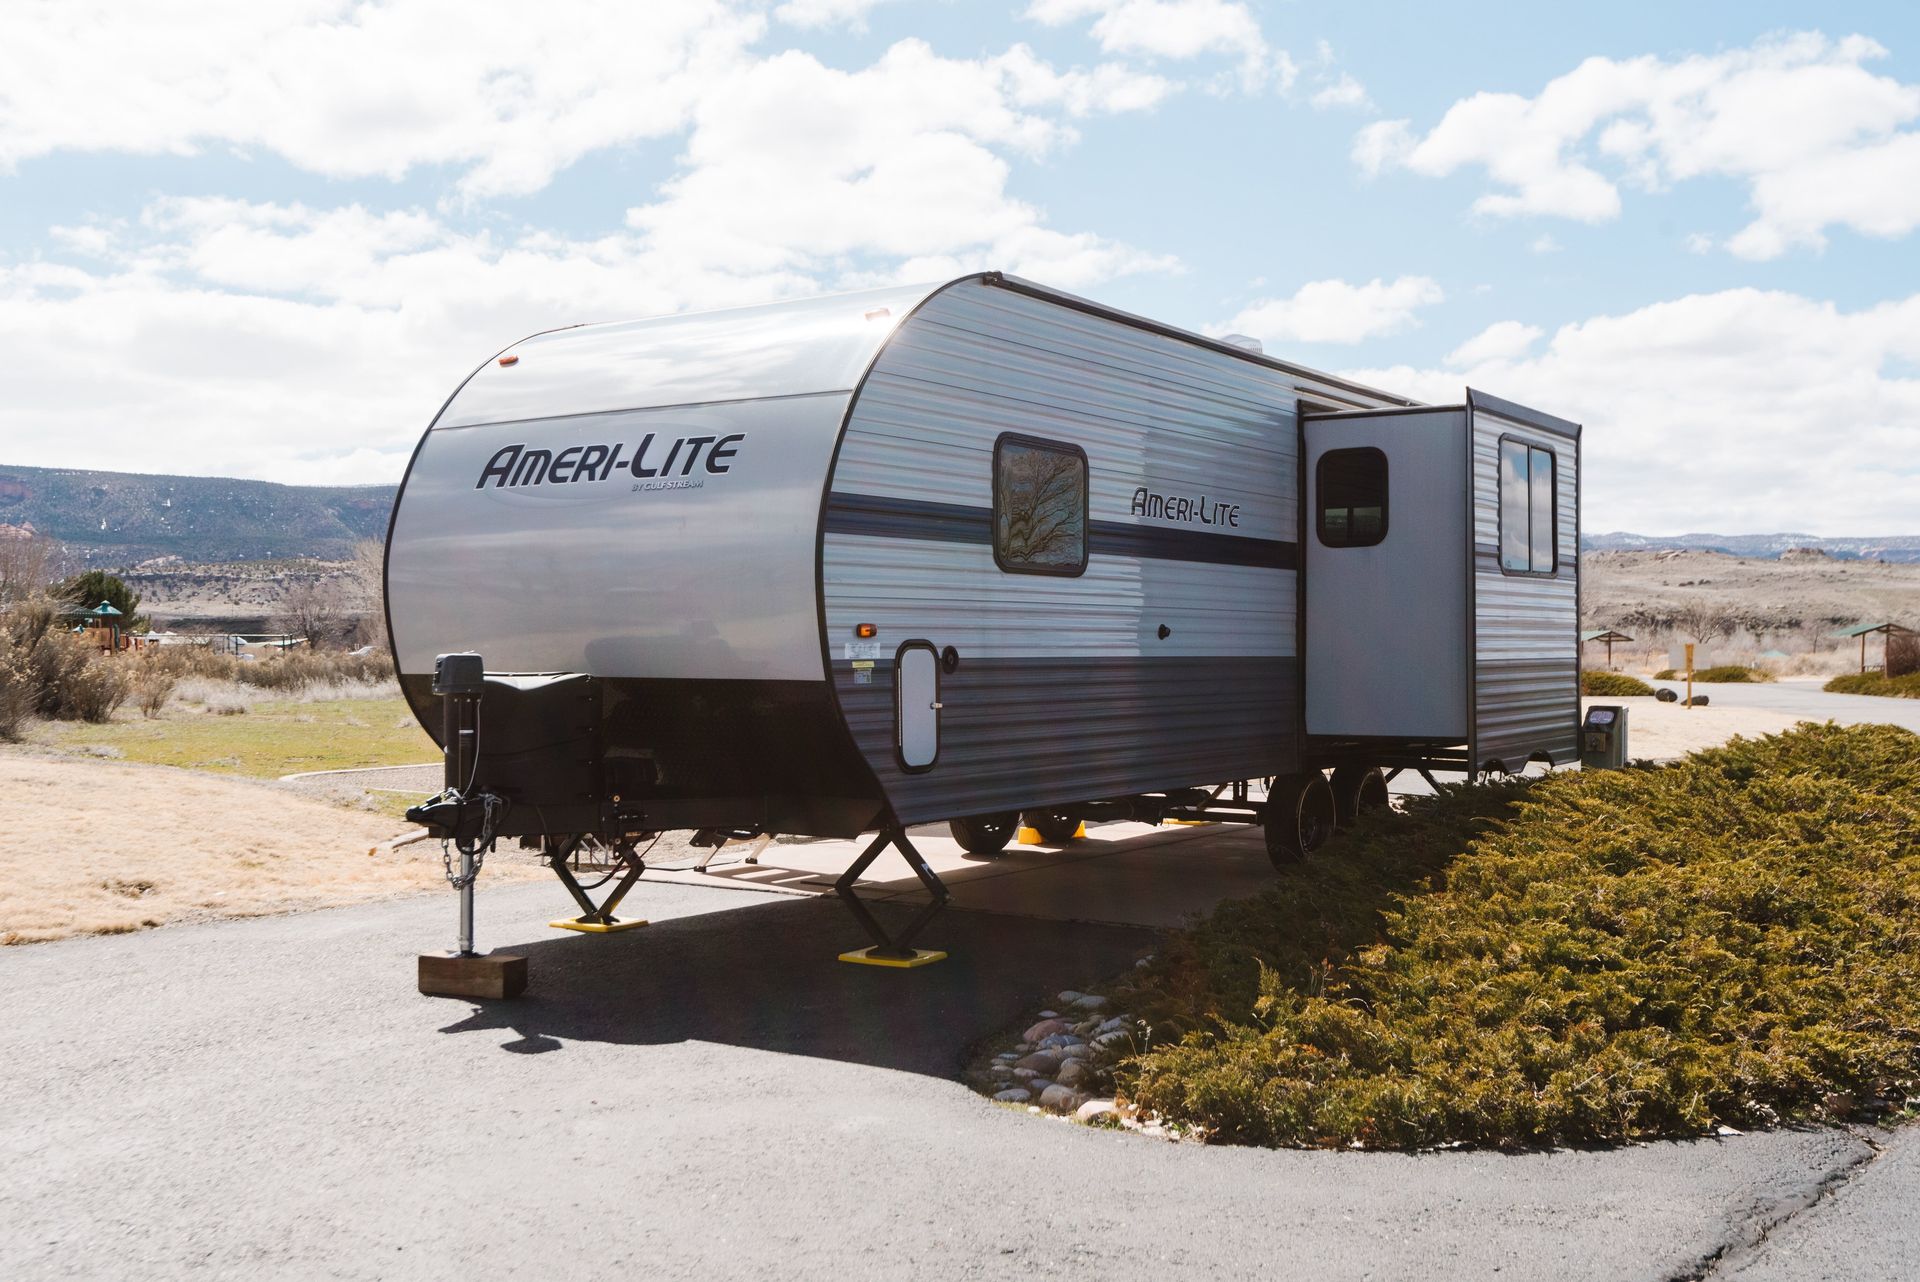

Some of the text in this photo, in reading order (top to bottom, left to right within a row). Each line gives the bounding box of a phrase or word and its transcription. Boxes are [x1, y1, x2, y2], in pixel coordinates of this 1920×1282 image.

[475, 432, 747, 490] AMERI-LITE
[632, 480, 704, 491] BY GULF STREAM
[1130, 486, 1240, 527] AMERI-LITE
